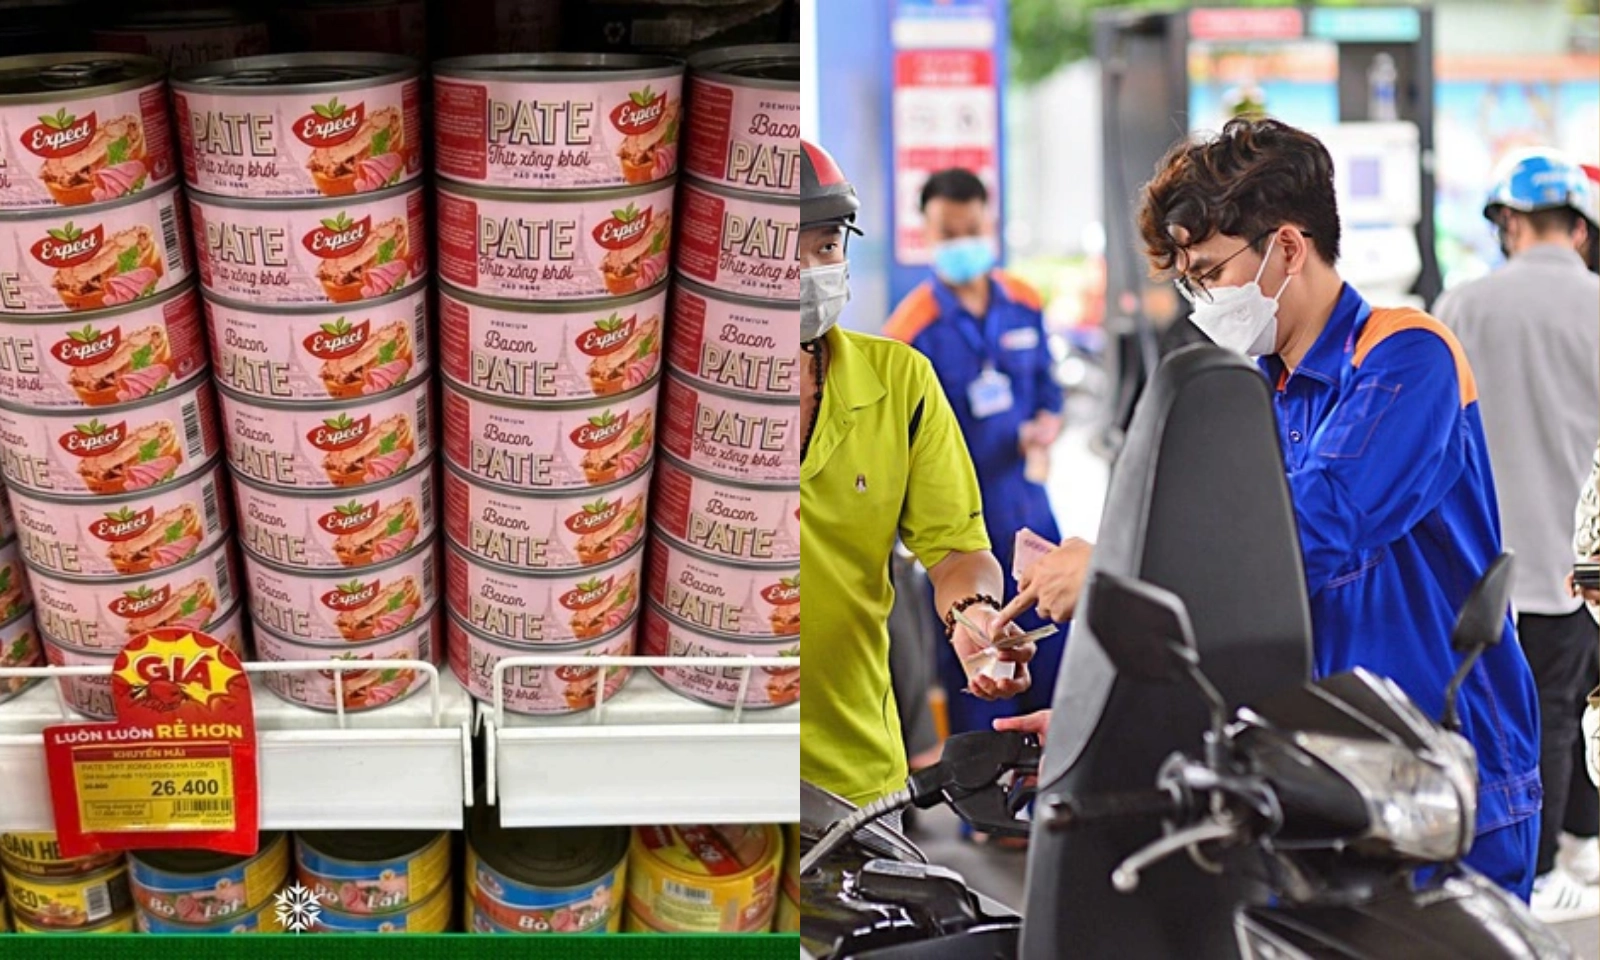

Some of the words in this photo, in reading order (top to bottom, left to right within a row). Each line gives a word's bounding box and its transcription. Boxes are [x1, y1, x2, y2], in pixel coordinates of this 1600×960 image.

[303, 110, 358, 138] Expect
[488, 99, 593, 145] PATE
[618, 102, 662, 126] Expect
[749, 113, 800, 138] Baco
[32, 124, 91, 150] Expect
[192, 111, 276, 157] PATE
[248, 160, 279, 178] khói
[488, 145, 518, 167] Thịt
[520, 151, 553, 171] xông
[558, 151, 591, 167] khói
[312, 223, 364, 250] Expect
[478, 215, 576, 260] PATE
[600, 216, 646, 242] Expect
[722, 212, 800, 261] PAT
[41, 233, 97, 260] Expect
[206, 222, 287, 267] PATE
[260, 270, 290, 286] khói
[479, 256, 504, 278] Thịt
[507, 264, 538, 283] xông
[542, 264, 574, 281] khói
[720, 252, 747, 275] Thịt
[749, 263, 782, 282] xông
[61, 333, 115, 359] Expect
[225, 328, 268, 353] Bacon
[312, 328, 364, 353] Expect
[485, 330, 537, 354] Bacon
[584, 323, 630, 350] Expect
[719, 323, 776, 349] Bacon
[223, 351, 292, 397] PATE
[471, 350, 558, 397] PATE
[700, 342, 796, 392] PATE
[235, 418, 274, 444] Bacon
[315, 422, 364, 445] Expect
[484, 423, 533, 447] Bacon
[578, 418, 623, 443] Expect
[695, 402, 788, 452] PATE
[68, 430, 120, 451] Expect
[233, 443, 296, 484] PATE
[471, 440, 553, 486] PATE
[719, 449, 749, 467] xông
[751, 452, 781, 467] khói
[248, 503, 286, 528] Bacon
[326, 507, 372, 528] Expect
[482, 507, 530, 531] Bacon
[573, 504, 617, 527] Expect
[706, 498, 758, 521] Bacon
[98, 514, 147, 536] Expect
[687, 512, 776, 558] PATE
[470, 522, 548, 567] PATE
[329, 585, 375, 605] Expect
[481, 584, 526, 607] Bacon
[566, 581, 608, 605] Expect
[680, 570, 725, 597] Bacon
[117, 591, 166, 613] Expect
[665, 581, 743, 633] PATE
[469, 596, 544, 641] PATE
[133, 651, 214, 692] GIÁ
[55, 728, 102, 744] LUÔN
[107, 727, 154, 740] LUÔN
[157, 719, 187, 738] RẺ
[192, 724, 243, 738] HƠN
[151, 779, 219, 796] 26.400
